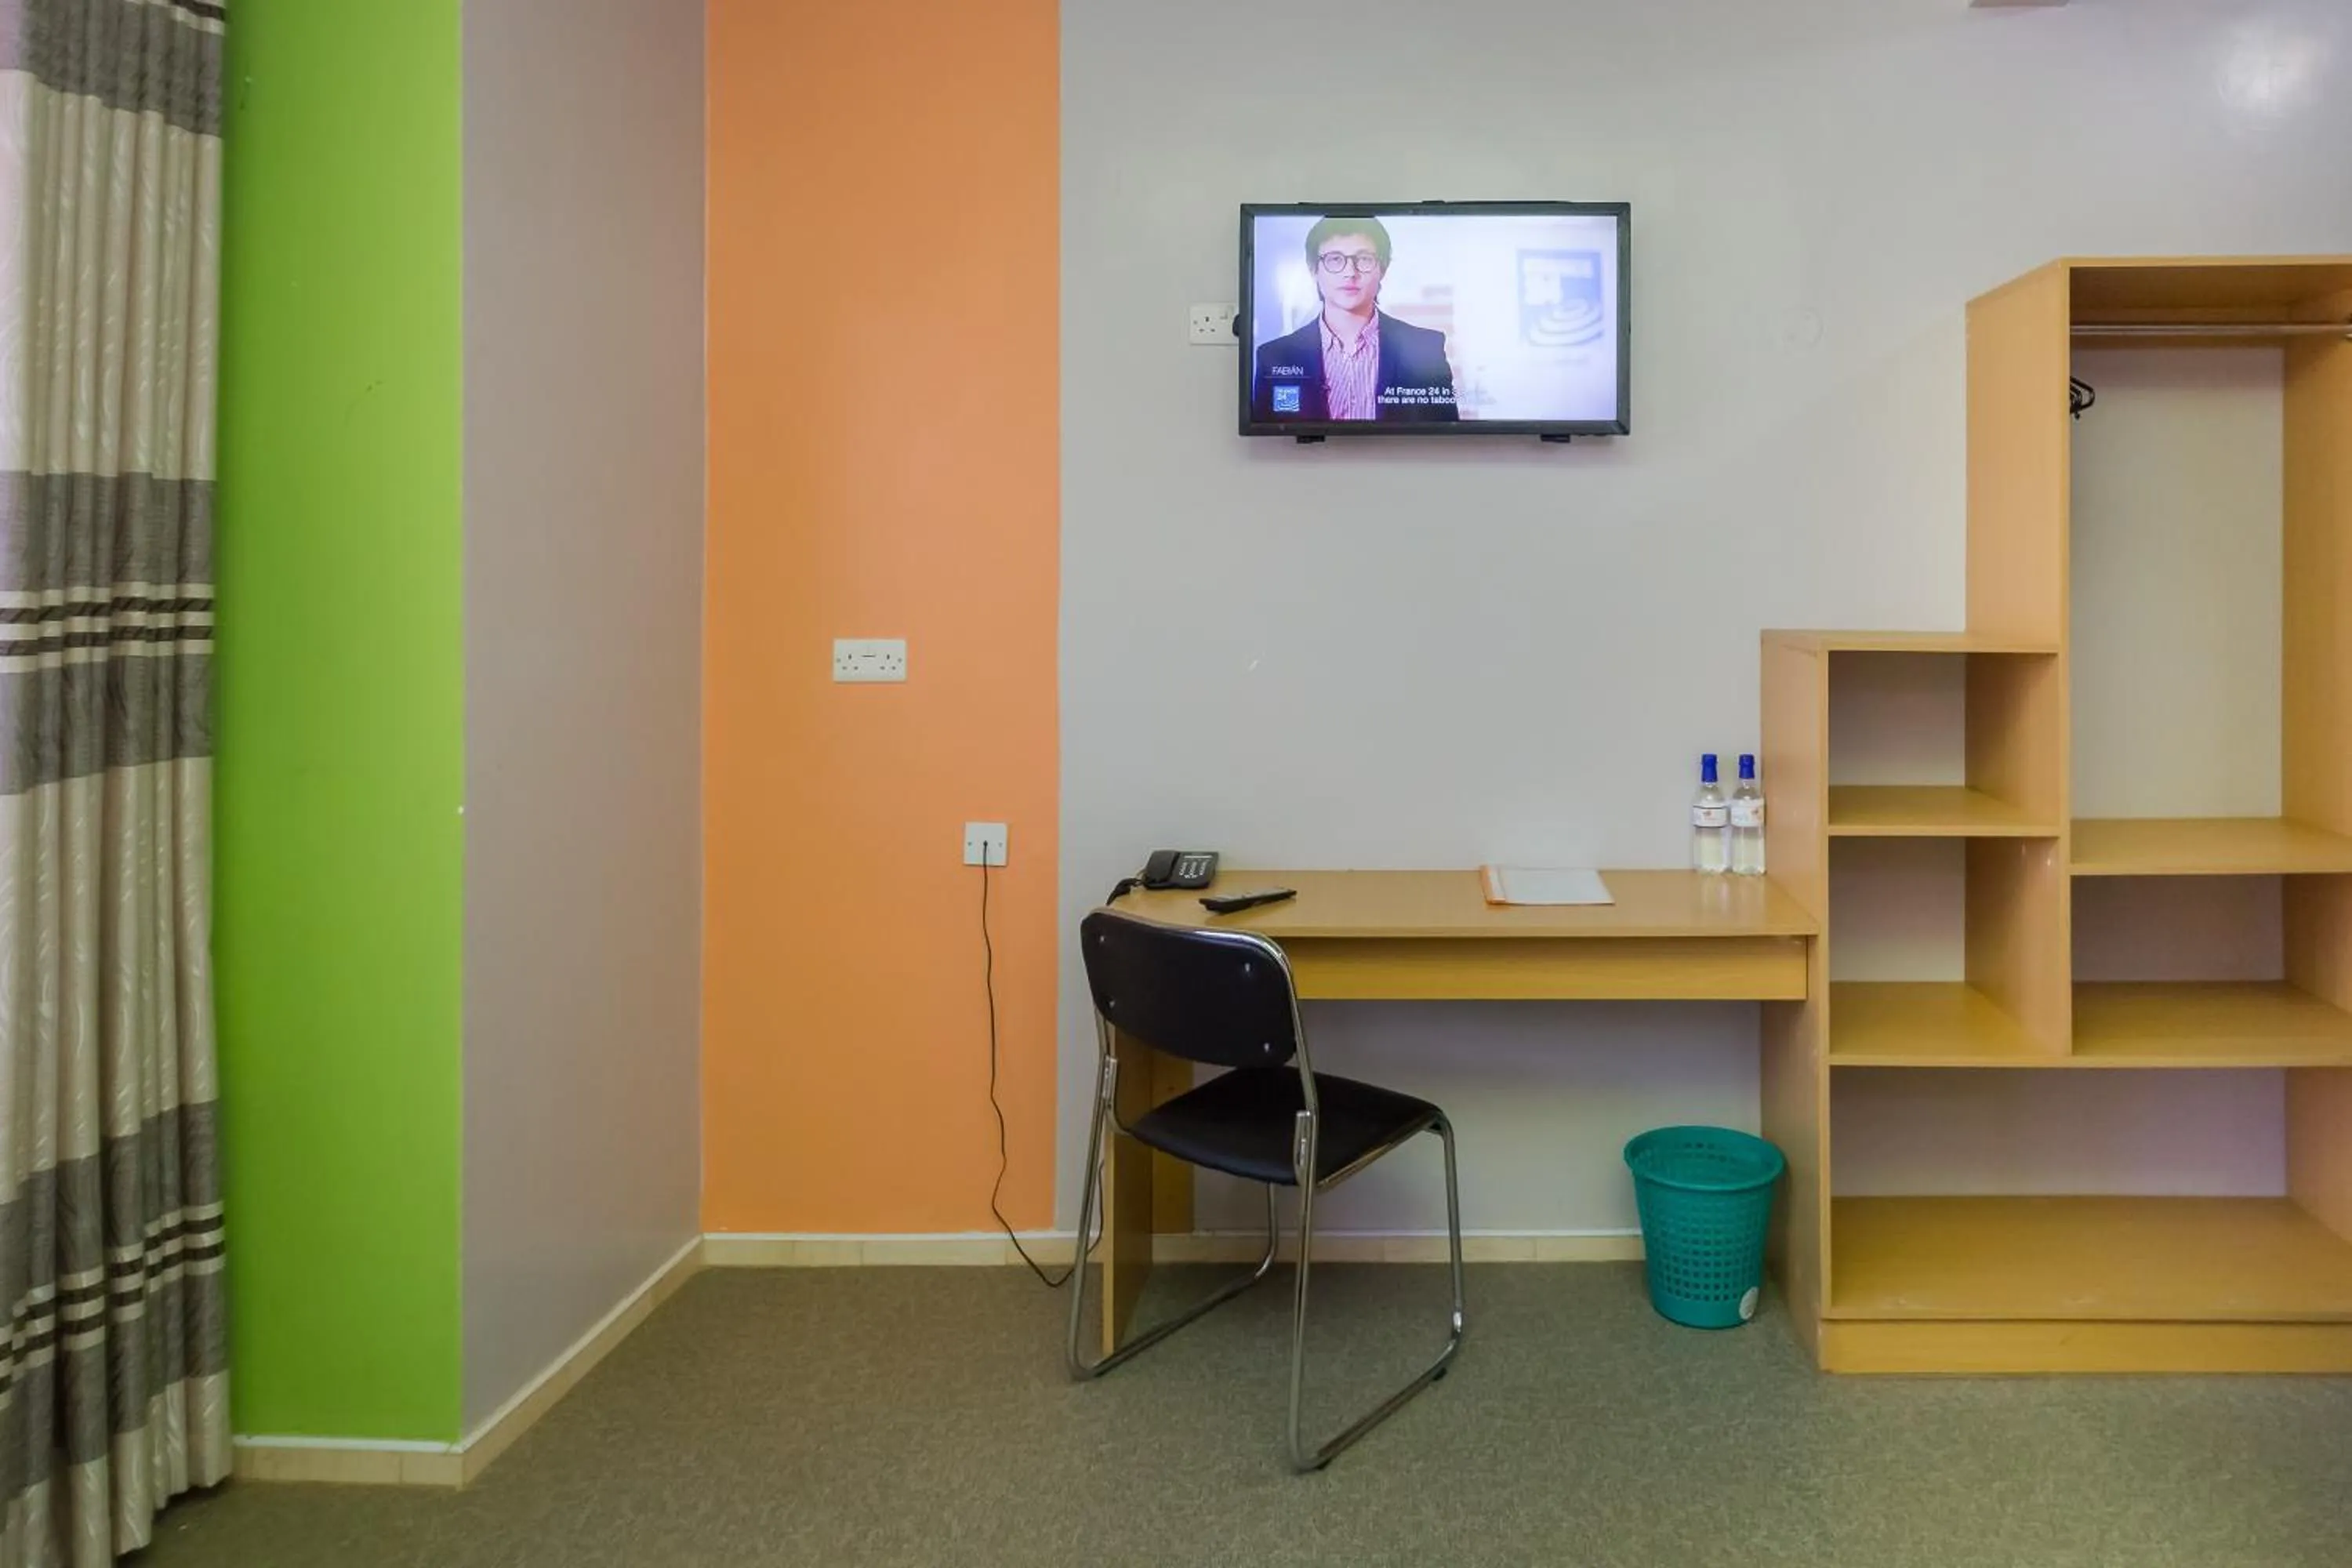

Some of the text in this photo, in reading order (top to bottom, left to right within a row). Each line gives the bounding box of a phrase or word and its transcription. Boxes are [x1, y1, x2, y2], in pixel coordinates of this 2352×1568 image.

[1384, 387, 1395, 395] At
[1396, 387, 1426, 395] France
[1428, 387, 1439, 395] 24
[1442, 387, 1450, 395] in
[1377, 395, 1399, 404] there
